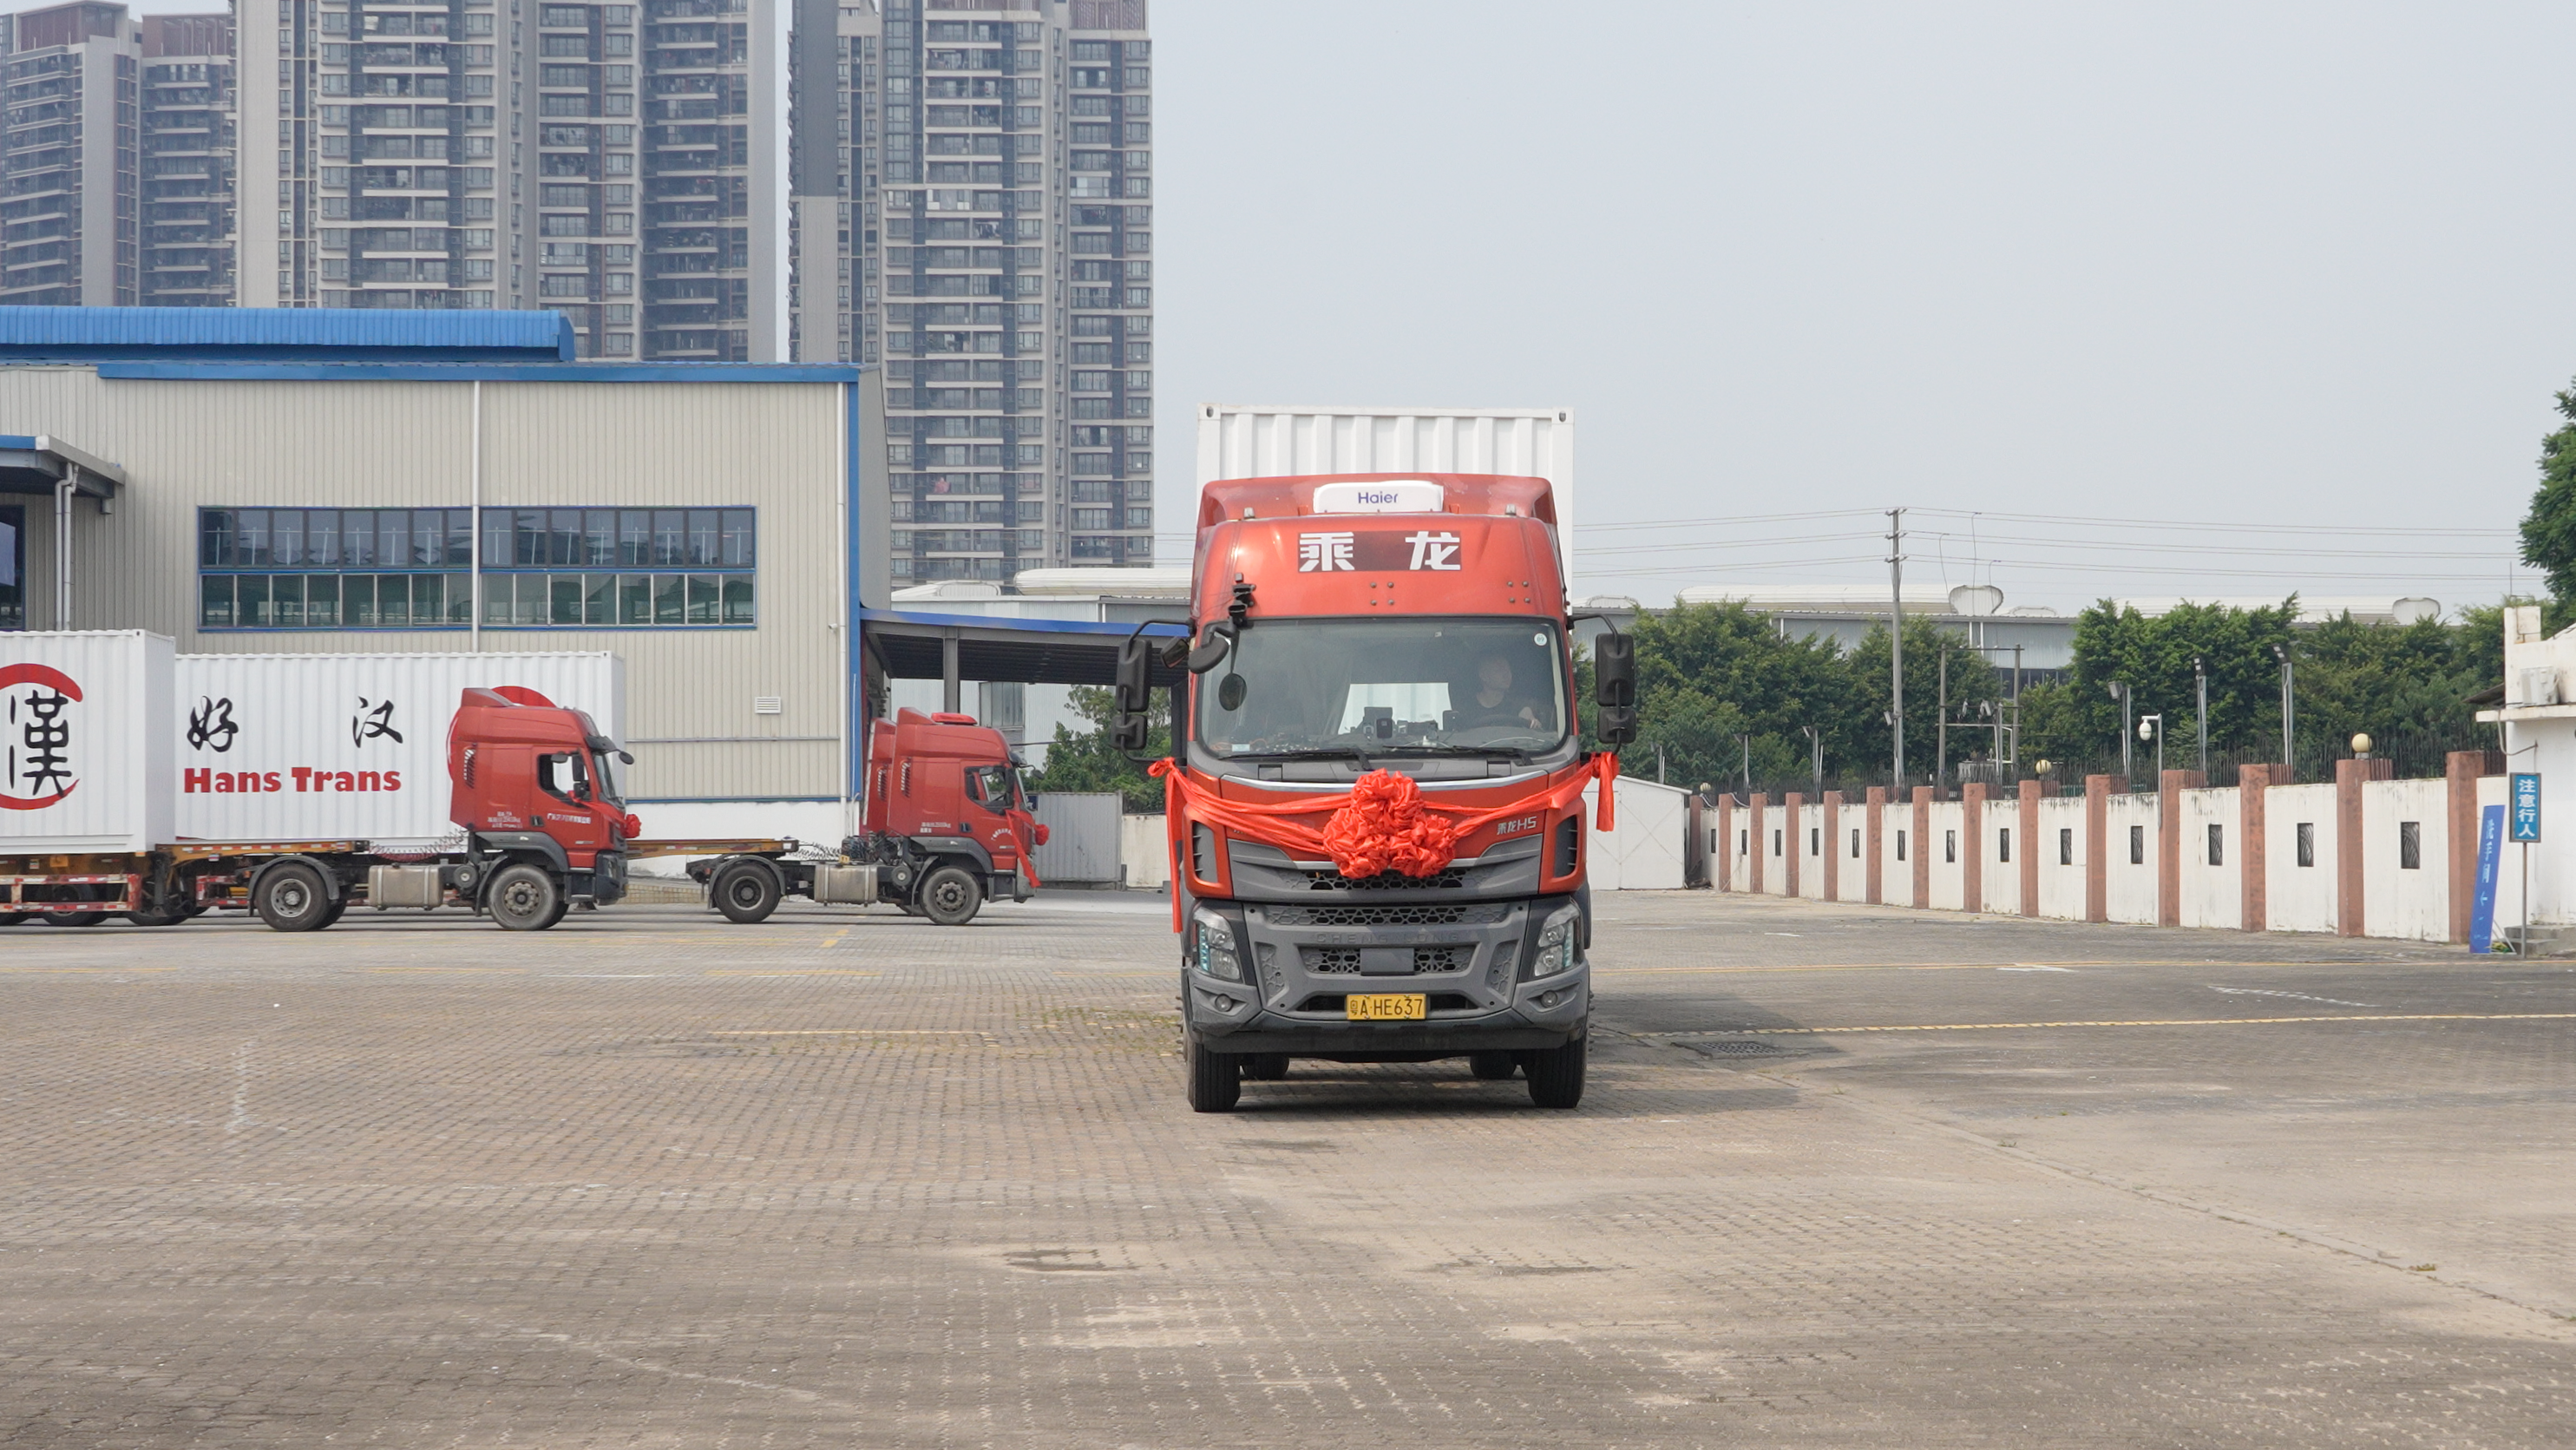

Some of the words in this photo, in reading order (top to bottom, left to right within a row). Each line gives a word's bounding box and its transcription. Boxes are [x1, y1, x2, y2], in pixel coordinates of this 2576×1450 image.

[1358, 491, 1399, 504] Haier
[1300, 531, 1461, 572] 乘龙
[184, 768, 282, 793] Hans
[291, 767, 402, 792] Trans
[2518, 778, 2536, 837] 注意行人
[1316, 933, 1388, 943] CHENG
